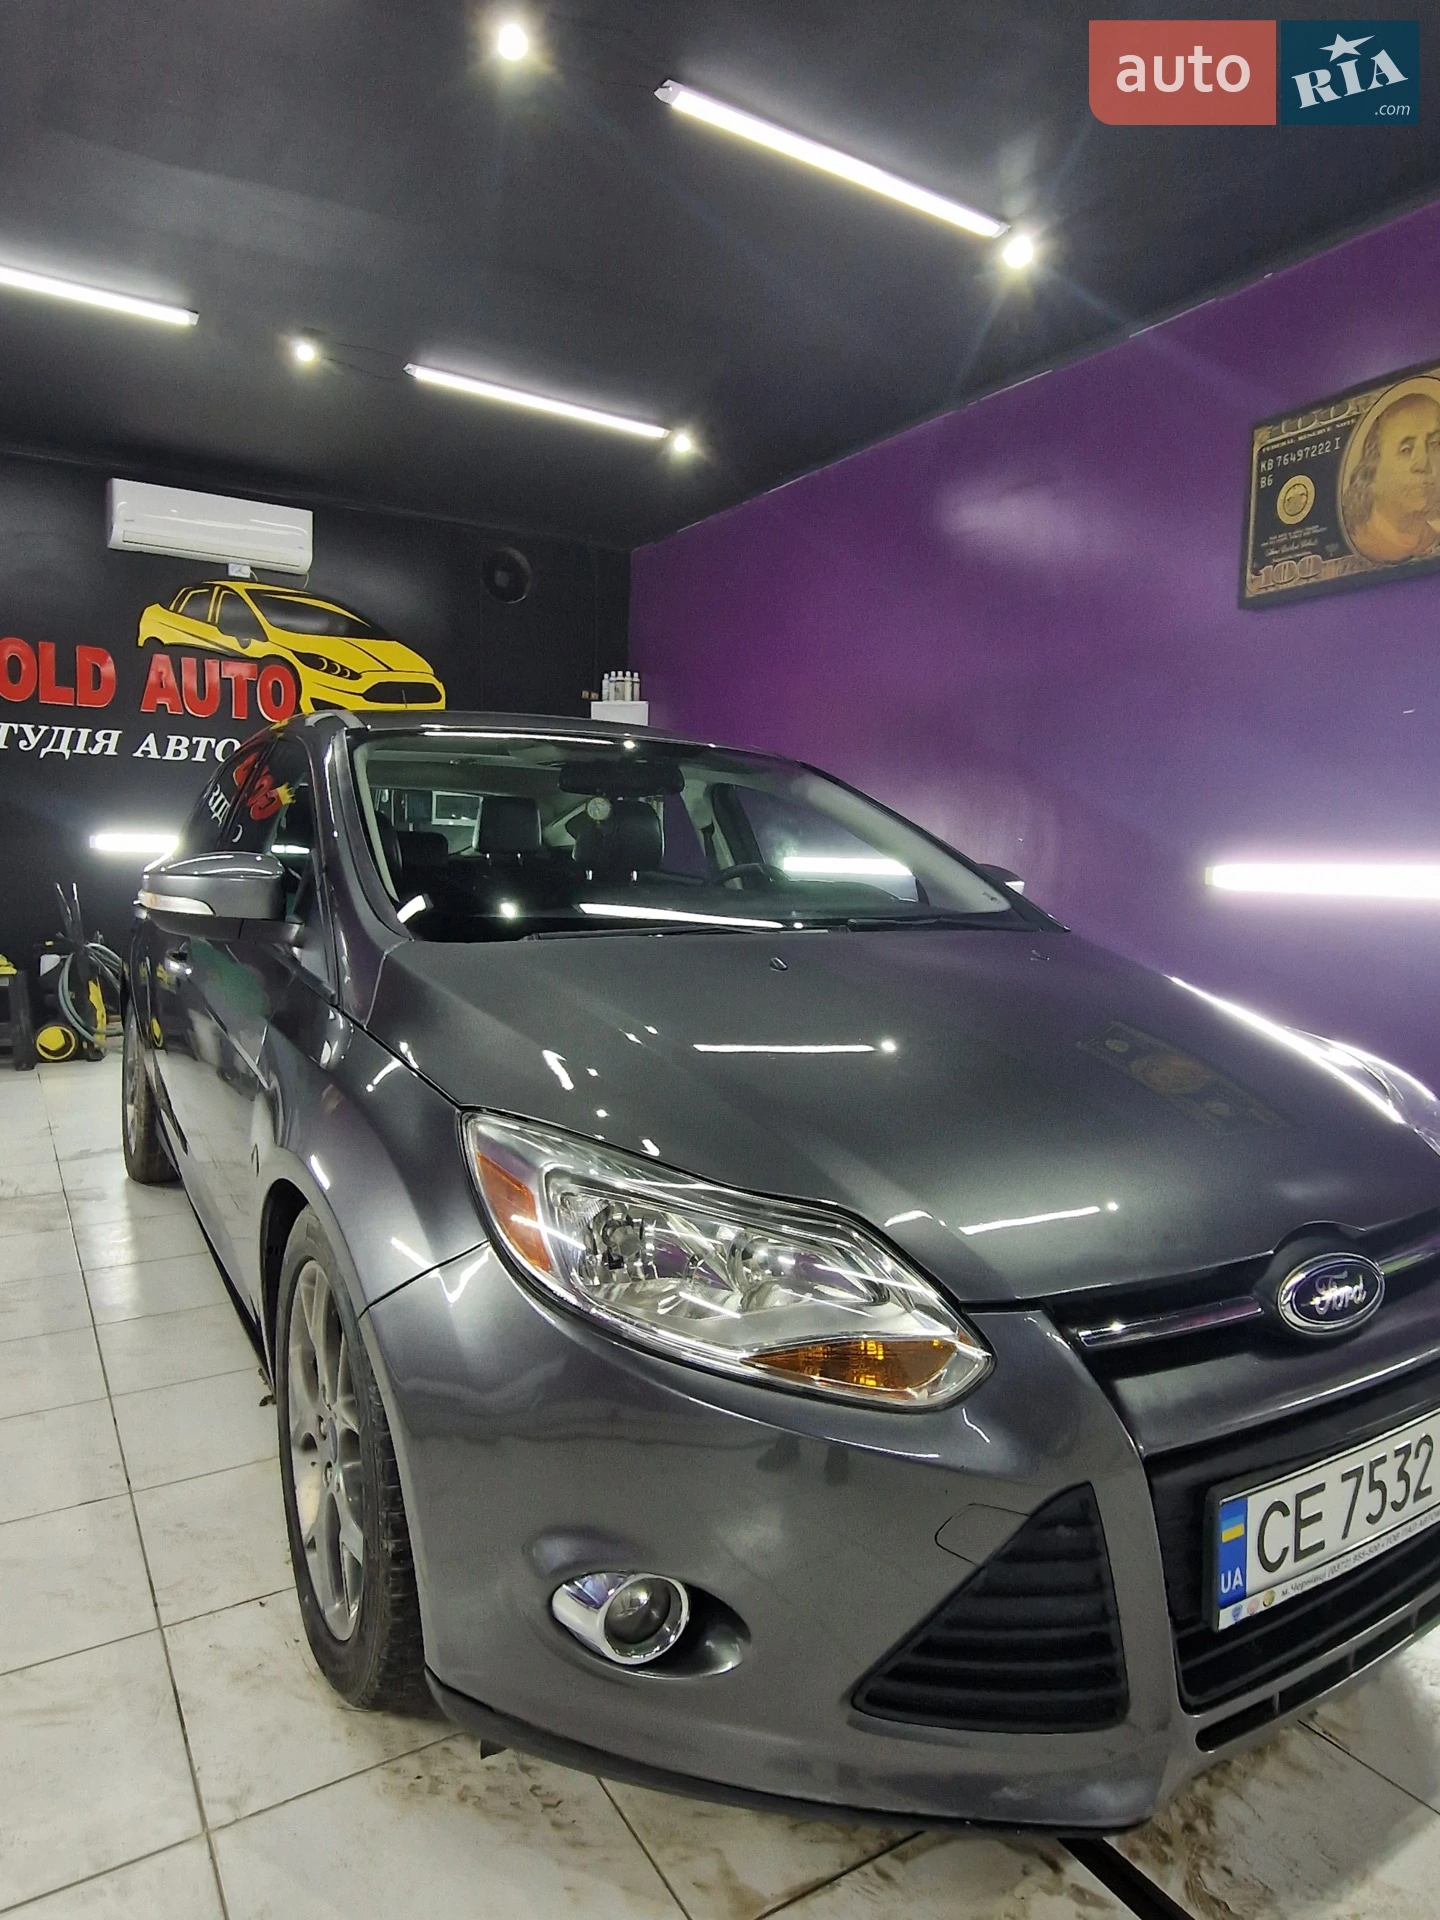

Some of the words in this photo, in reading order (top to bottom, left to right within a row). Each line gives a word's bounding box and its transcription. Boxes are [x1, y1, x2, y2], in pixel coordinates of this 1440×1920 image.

[1260, 458, 1274, 473] KB
[1276, 440, 1332, 467] 76497222
[1260, 474, 1274, 489] B6
[140, 653, 296, 723] AUTO
[1304, 1270, 1367, 1315] Ford
[1257, 1482, 1326, 1573] CE
[1341, 1433, 1434, 1540] 7532
[1220, 1567, 1244, 1594] UA
